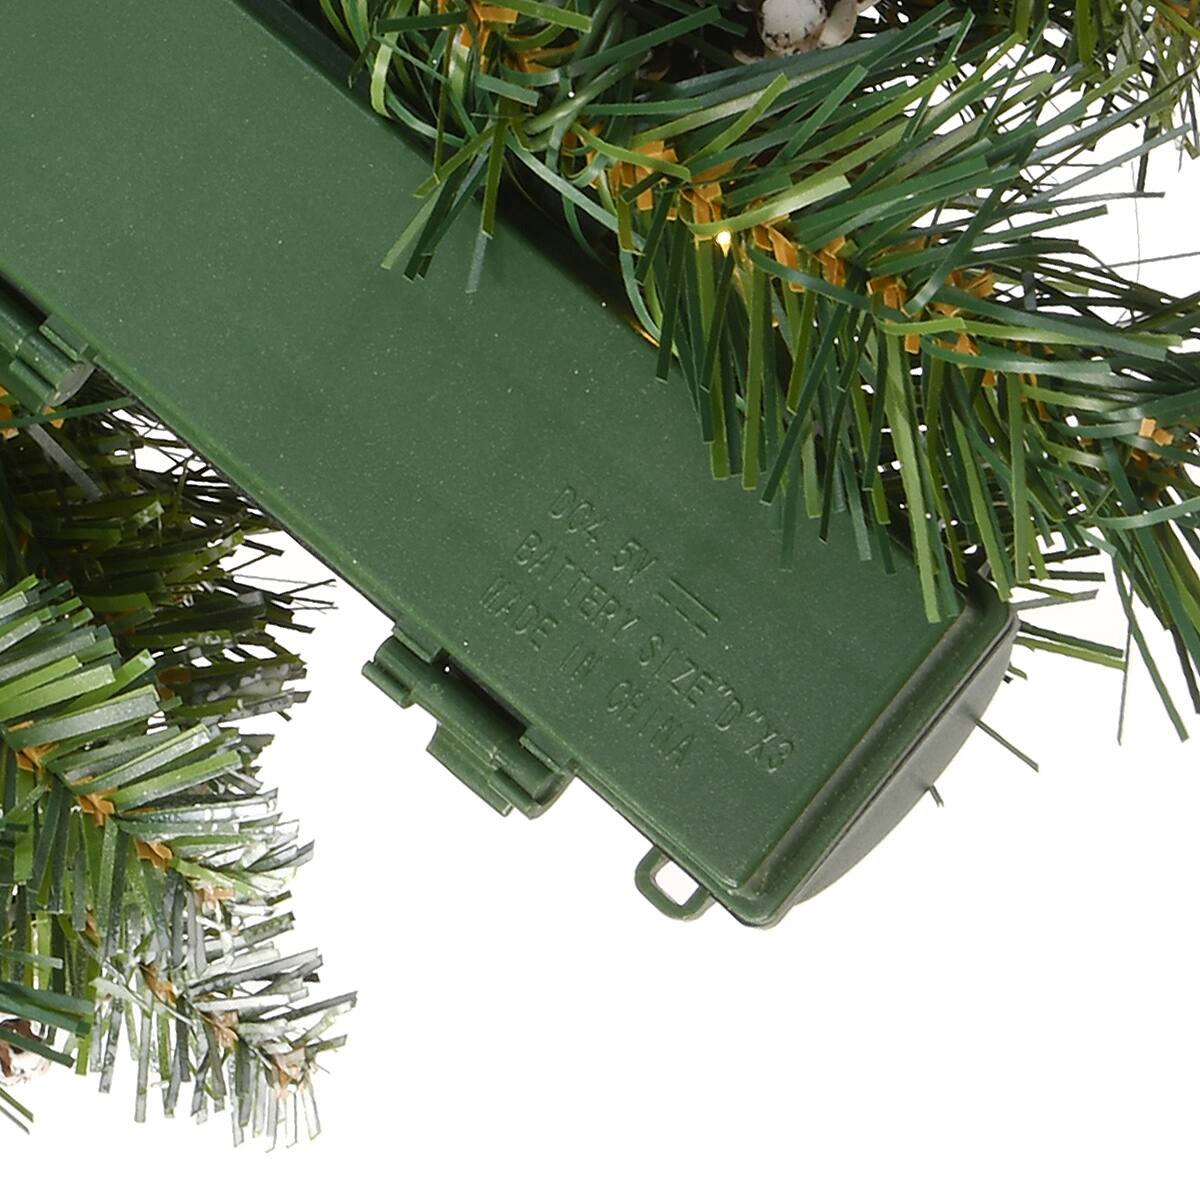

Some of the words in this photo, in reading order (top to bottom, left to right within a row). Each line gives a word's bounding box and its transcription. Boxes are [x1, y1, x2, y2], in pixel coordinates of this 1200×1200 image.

[513, 530, 640, 642] BATTERY
[479, 575, 559, 651] MADE
[560, 642, 601, 681] IN
[607, 681, 696, 769] CHINA
